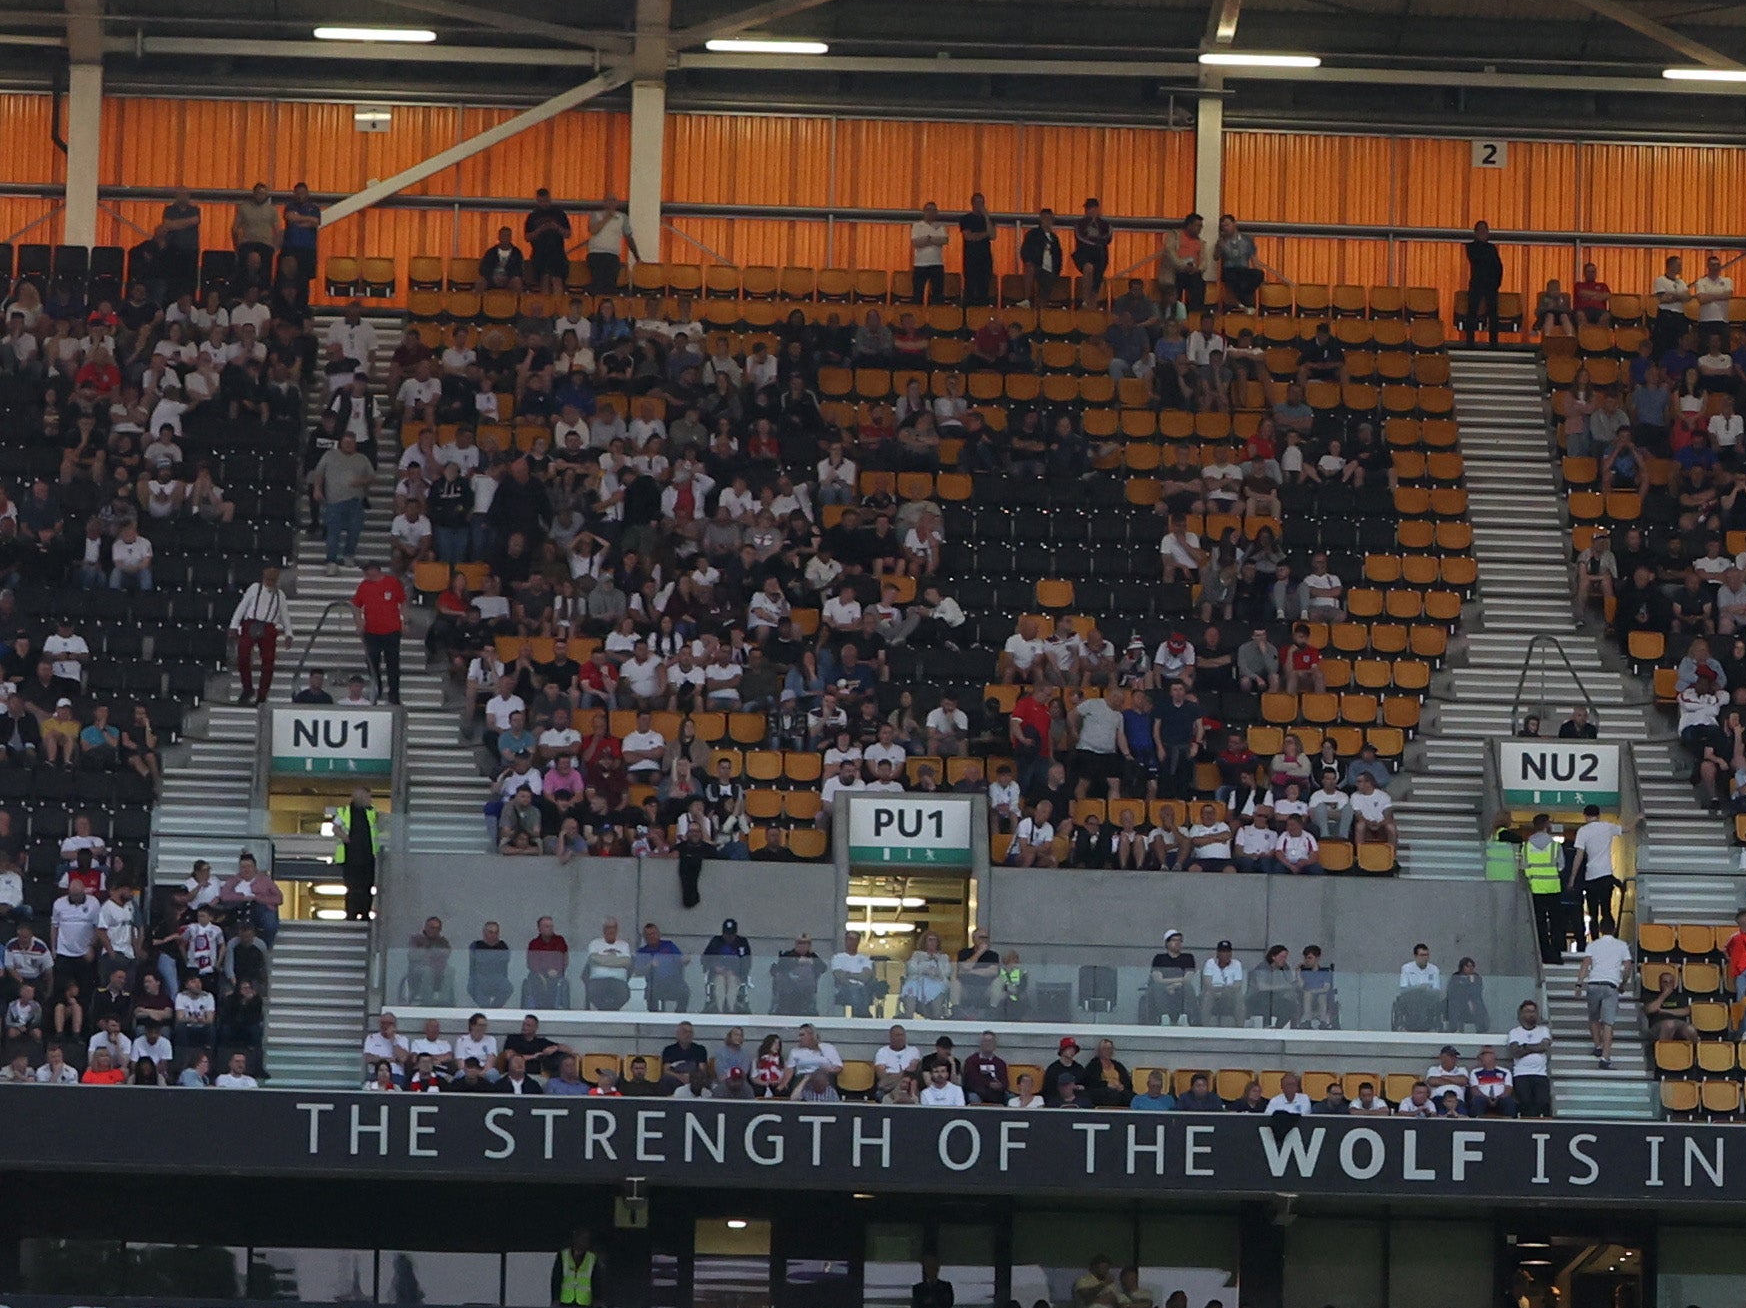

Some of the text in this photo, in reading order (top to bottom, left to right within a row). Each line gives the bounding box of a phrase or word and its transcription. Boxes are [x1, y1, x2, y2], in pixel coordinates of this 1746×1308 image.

[1482, 144, 1497, 164] 2
[293, 718, 370, 749] NU1
[1521, 752, 1599, 782] NU2
[873, 808, 945, 839] PU1
[296, 1101, 439, 1157] THE
[483, 1105, 893, 1169] STRENGTH
[937, 1118, 1029, 1173] OF
[1073, 1122, 1215, 1177] THE
[1259, 1125, 1485, 1183] WOLF
[1530, 1133, 1600, 1187] IS
[1645, 1136, 1725, 1189] IN
